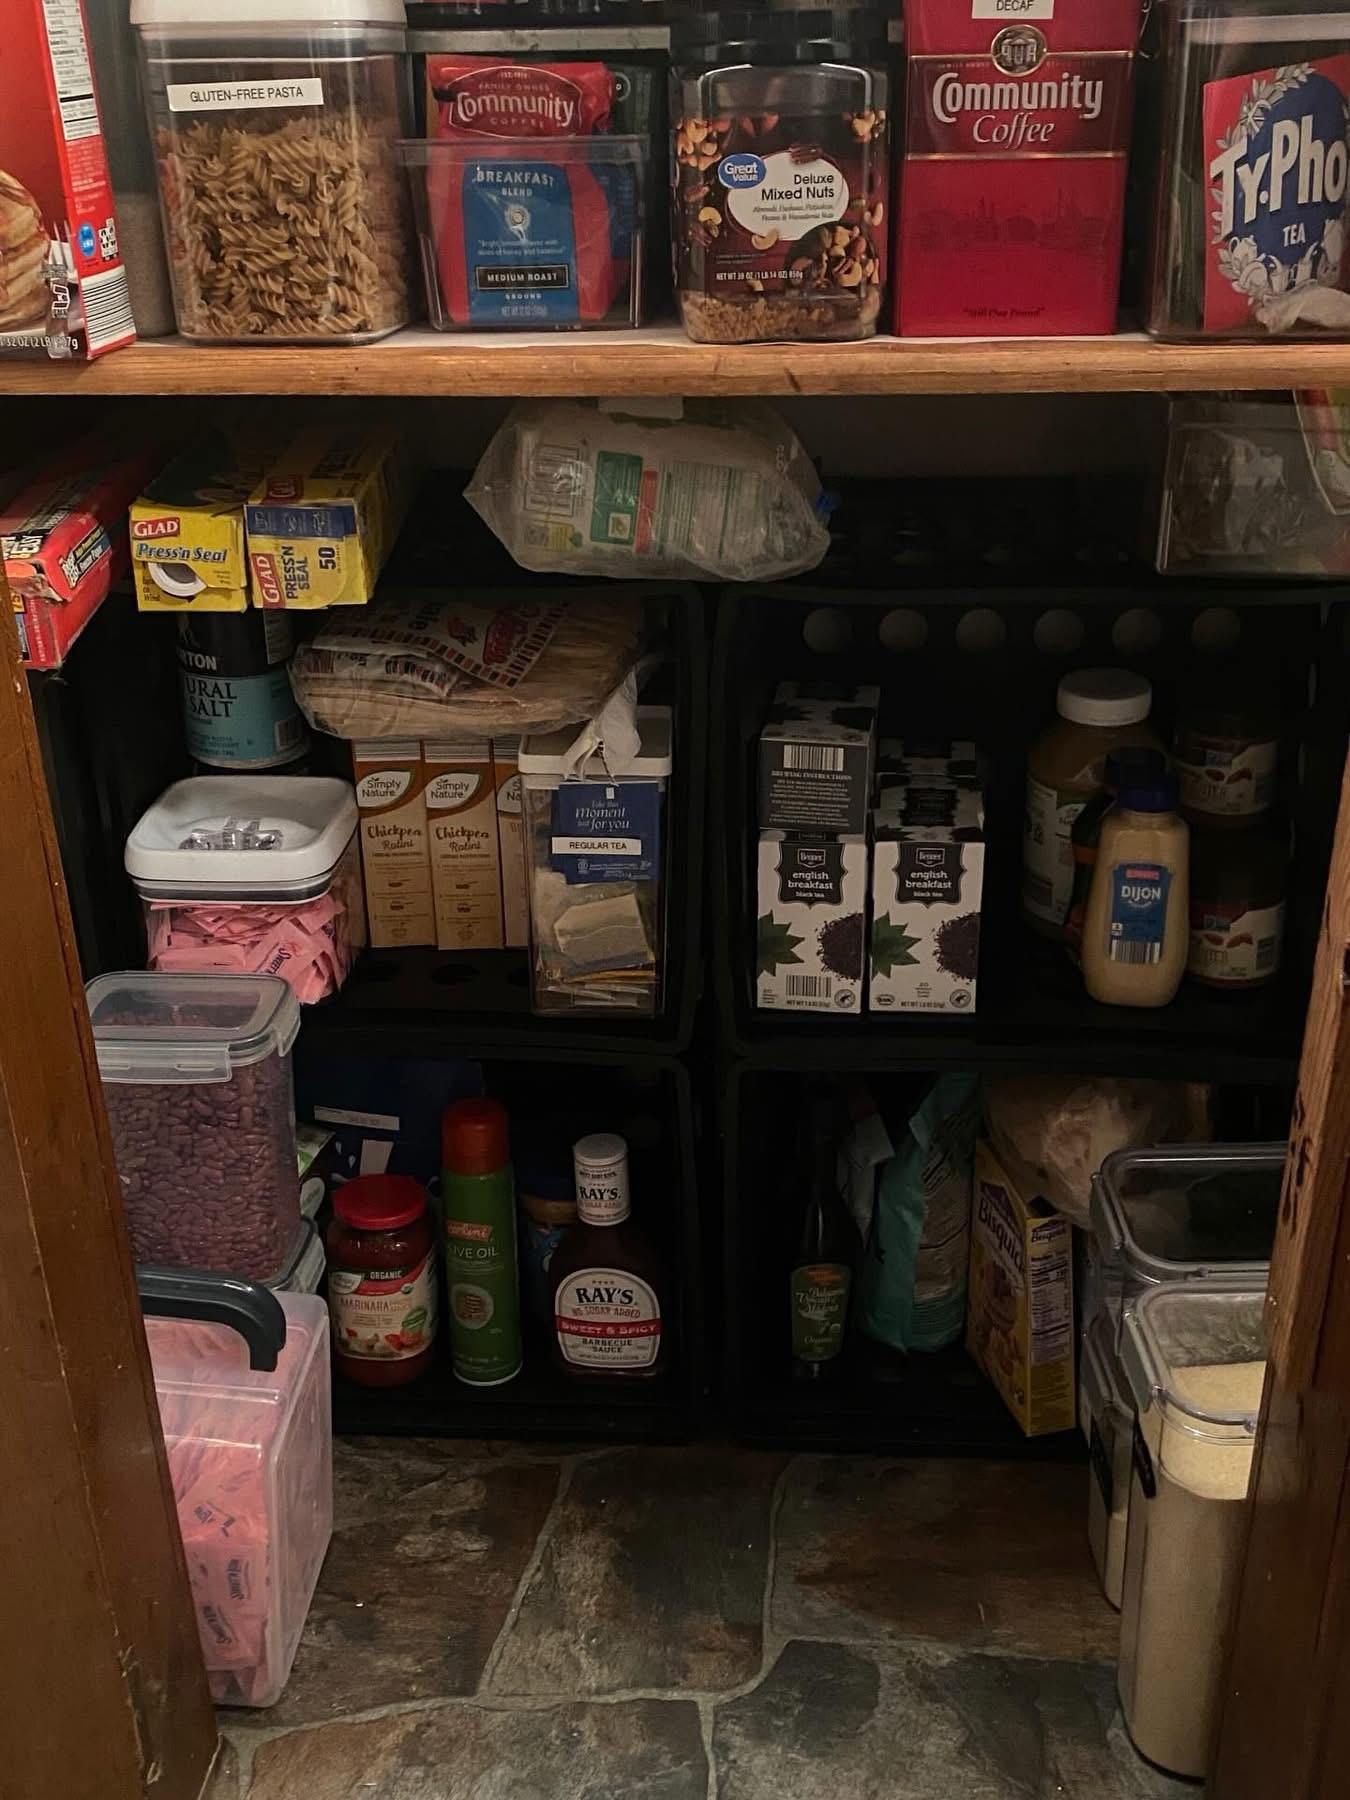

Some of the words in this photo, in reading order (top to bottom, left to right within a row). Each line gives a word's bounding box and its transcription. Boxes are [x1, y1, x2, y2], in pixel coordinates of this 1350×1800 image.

[996, 0, 1034, 11] DECAF
[189, 87, 265, 103] GLUTEN-FREE
[267, 86, 303, 100] PASTA
[932, 72, 1103, 123] Community
[456, 91, 574, 128] Community
[972, 112, 1055, 149] Coffee
[724, 162, 758, 175] Great
[476, 170, 554, 188] BREAKFAST
[733, 174, 758, 182] Value
[794, 174, 834, 185] Deluxe
[502, 187, 532, 197] BLEND
[761, 188, 802, 201] Mixed
[806, 187, 834, 199] Nuts
[1283, 222, 1306, 248] TEA
[487, 273, 525, 282] MEDIUM
[528, 272, 558, 281] ROAST
[134, 520, 179, 537] GLAD
[192, 546, 228, 561] Seal
[318, 546, 337, 570] 50
[255, 555, 281, 603] GLAD
[295, 556, 310, 591] SEAL
[189, 696, 233, 717] SALT
[367, 779, 401, 791] Simply
[436, 780, 470, 793] Simply
[362, 789, 396, 798] Nature
[431, 790, 464, 799] Nature
[367, 825, 422, 841] Chickpea
[436, 826, 489, 841] Chickpea
[569, 841, 609, 850] REGULAR
[611, 842, 627, 850] TEA
[792, 871, 829, 881] english
[910, 870, 948, 881] english
[788, 879, 833, 890] breakfast
[905, 879, 953, 889] breakfast
[1121, 885, 1162, 902] DIJON
[580, 1186, 619, 1200] RAY'S
[450, 1245, 472, 1259] IVE
[476, 1246, 497, 1259] OIL
[370, 1270, 403, 1280] ORGANIC
[576, 1287, 634, 1305] RAY'S
[582, 1338, 633, 1346] BARBECUE
[592, 1346, 623, 1354] SAUCE
